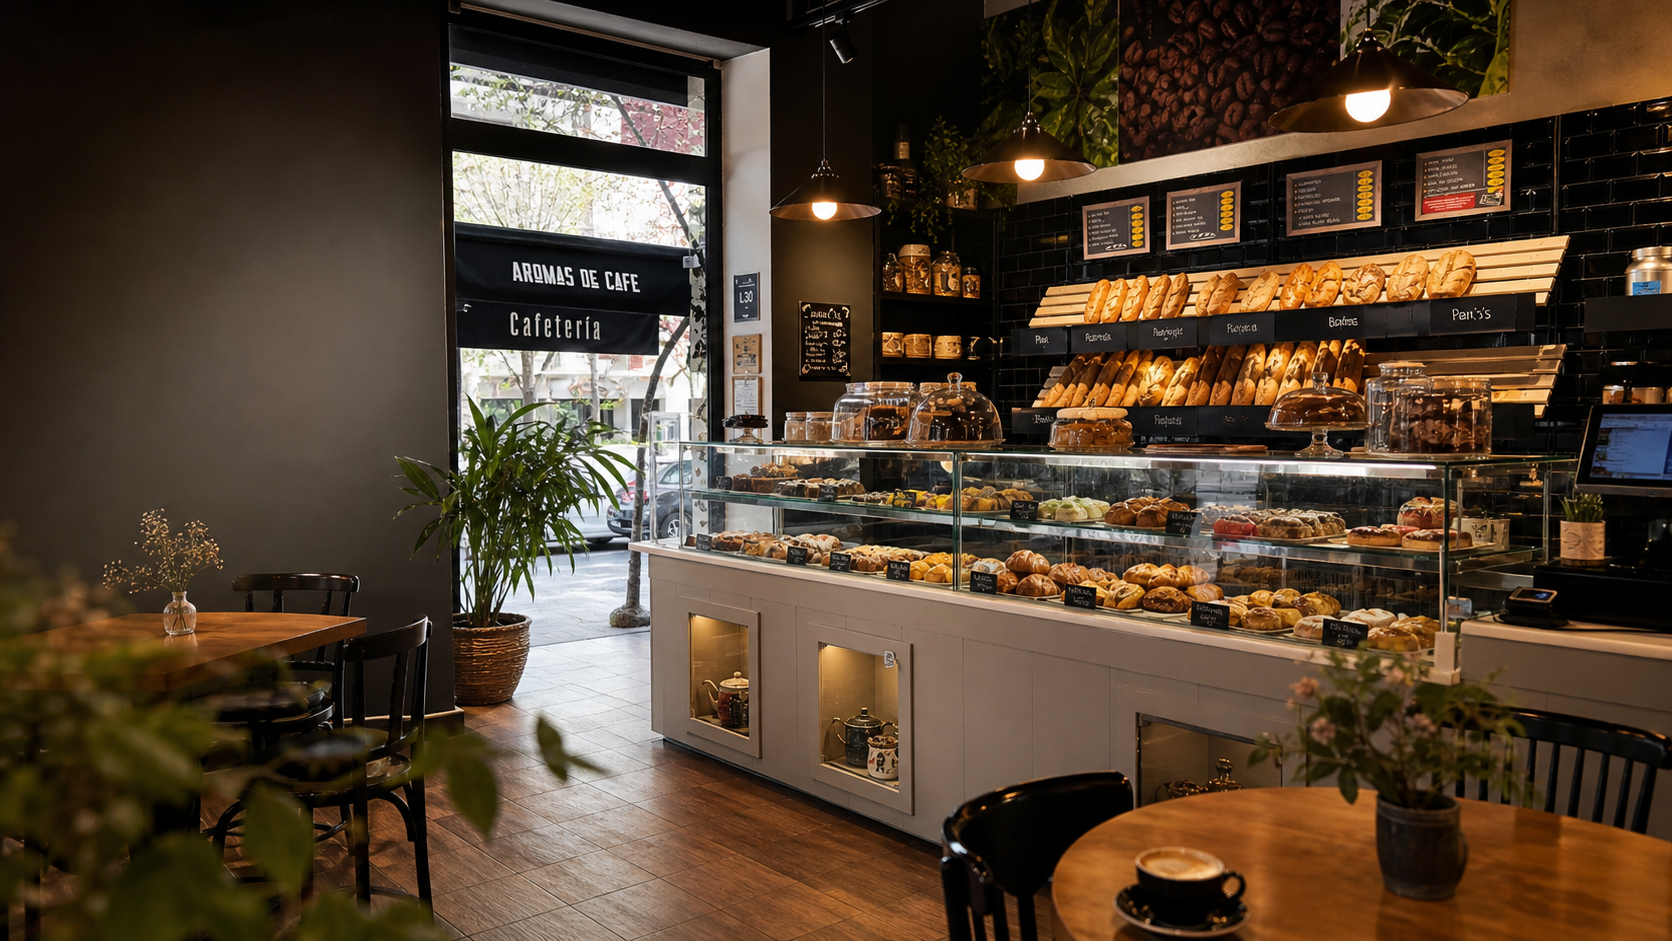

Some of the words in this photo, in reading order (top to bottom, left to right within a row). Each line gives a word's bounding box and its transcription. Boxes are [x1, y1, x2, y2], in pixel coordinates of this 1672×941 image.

[512, 261, 575, 287] AROMAS
[579, 268, 600, 289] DE
[604, 271, 641, 293] CAFE
[509, 311, 601, 341] Cafetería
